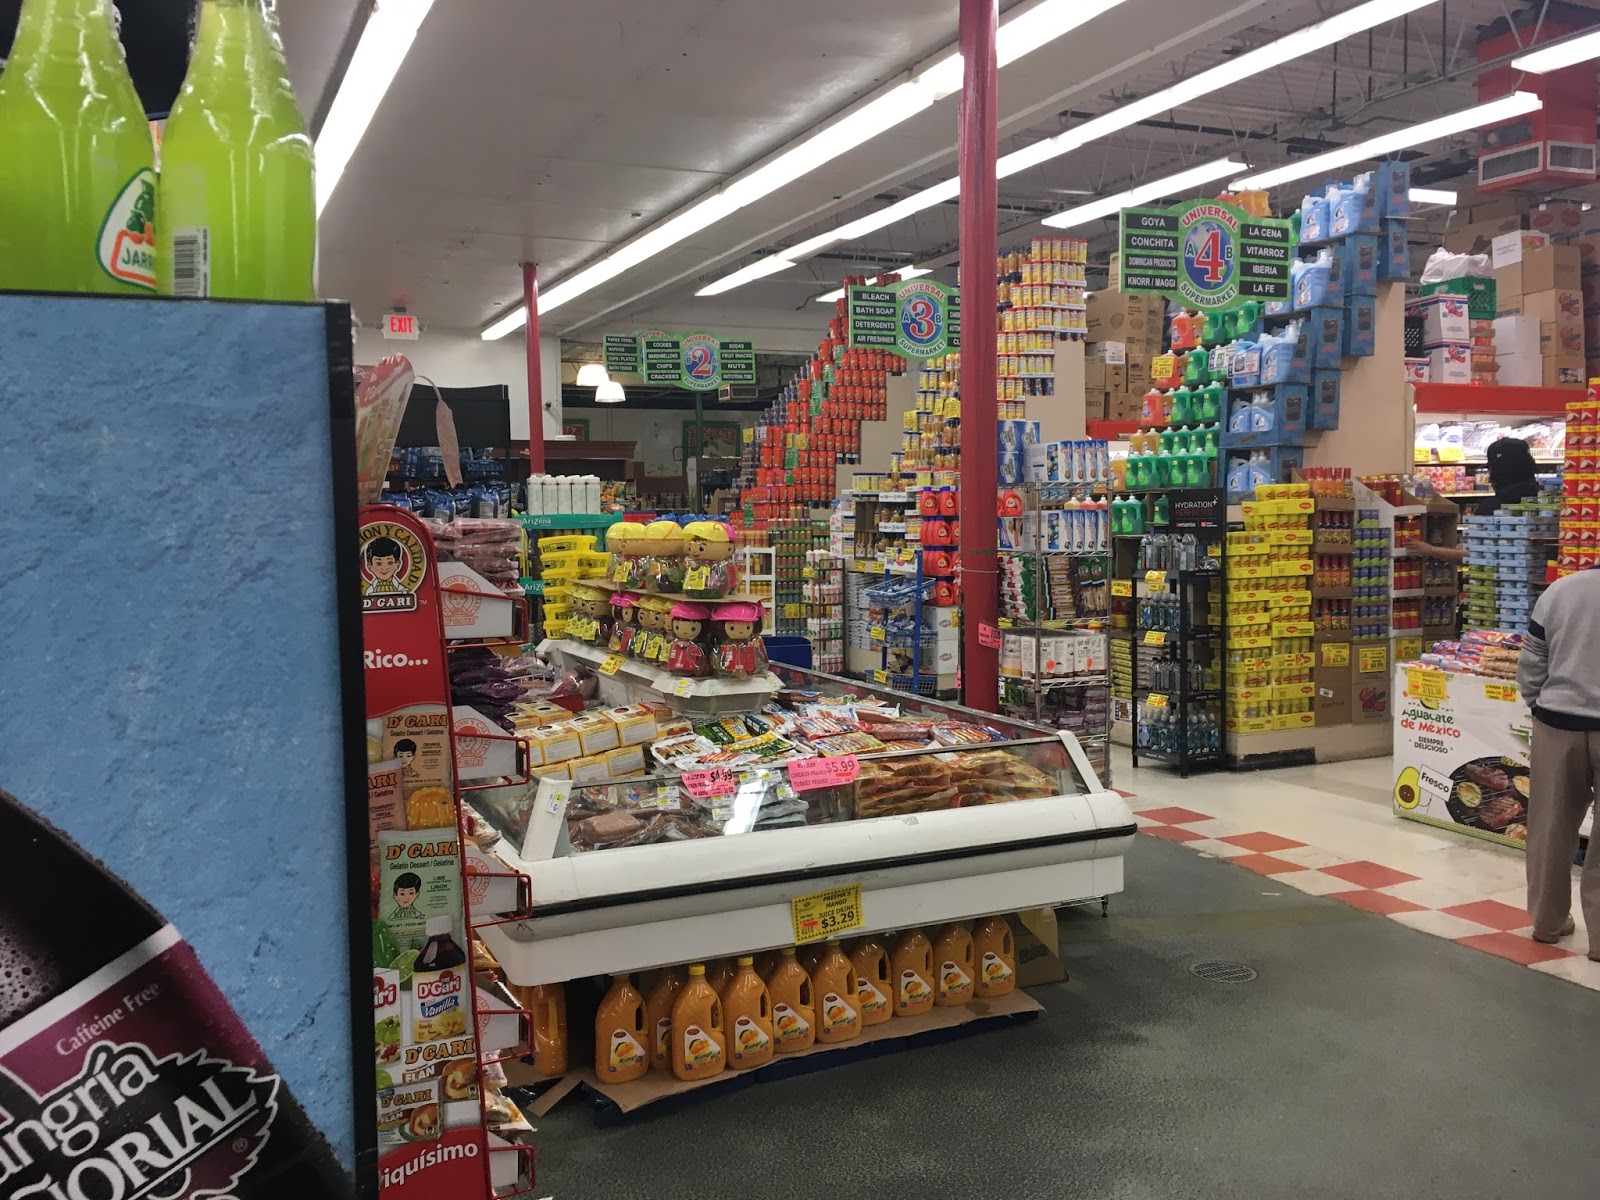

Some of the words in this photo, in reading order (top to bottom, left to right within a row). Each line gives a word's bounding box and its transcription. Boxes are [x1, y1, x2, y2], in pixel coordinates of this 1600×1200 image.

[1142, 217, 1165, 227] GOYA
[1182, 206, 1238, 231] UNIVERSAL
[1250, 227, 1259, 236] LA
[1261, 229, 1282, 238] CENA
[1131, 237, 1174, 248] CONCHITA
[122, 247, 156, 270] JARR
[1195, 231, 1224, 281] 4
[1247, 246, 1284, 258] VITARROZ
[1154, 258, 1176, 268] PRODUCTS
[1253, 265, 1277, 275] IBERIA
[1128, 277, 1150, 286] KNORR
[1155, 278, 1176, 287] MAGGI
[1253, 284, 1263, 292] LA
[1265, 285, 1274, 293] FE
[899, 284, 945, 301] UNIVERSAL
[1180, 283, 1236, 306] SUPERMARKET
[390, 316, 412, 333] EXIT
[856, 321, 894, 329] DETERGENTS
[910, 300, 935, 338] 3
[682, 335, 718, 347] UNIVERSAL
[899, 339, 945, 355] SUPERMARKET
[692, 347, 711, 375] 2
[684, 377, 720, 388] SUPERMARKET
[384, 525, 393, 535] Y
[377, 597, 411, 607] GARI
[1402, 709, 1454, 724] Aguacate
[1401, 718, 1415, 730] de
[1419, 721, 1461, 738] México
[1414, 741, 1448, 754] DELICIOSO
[1418, 736, 1444, 747] SIEMPRE
[825, 760, 854, 773] $5.99
[1421, 772, 1449, 793] Fresco
[826, 899, 847, 908] MANGO
[819, 910, 834, 919] JUICE
[836, 904, 854, 914] DRINK
[822, 911, 854, 929] $3.29
[426, 996, 455, 1016] Vanilla
[56, 1005, 124, 1056] Caffeine
[125, 981, 161, 1012] Free
[406, 1065, 435, 1082] FLAN
[0, 1051, 160, 1185] ngría
[30, 1076, 256, 1200] ORIAL
[380, 1142, 478, 1189] iquísimo
